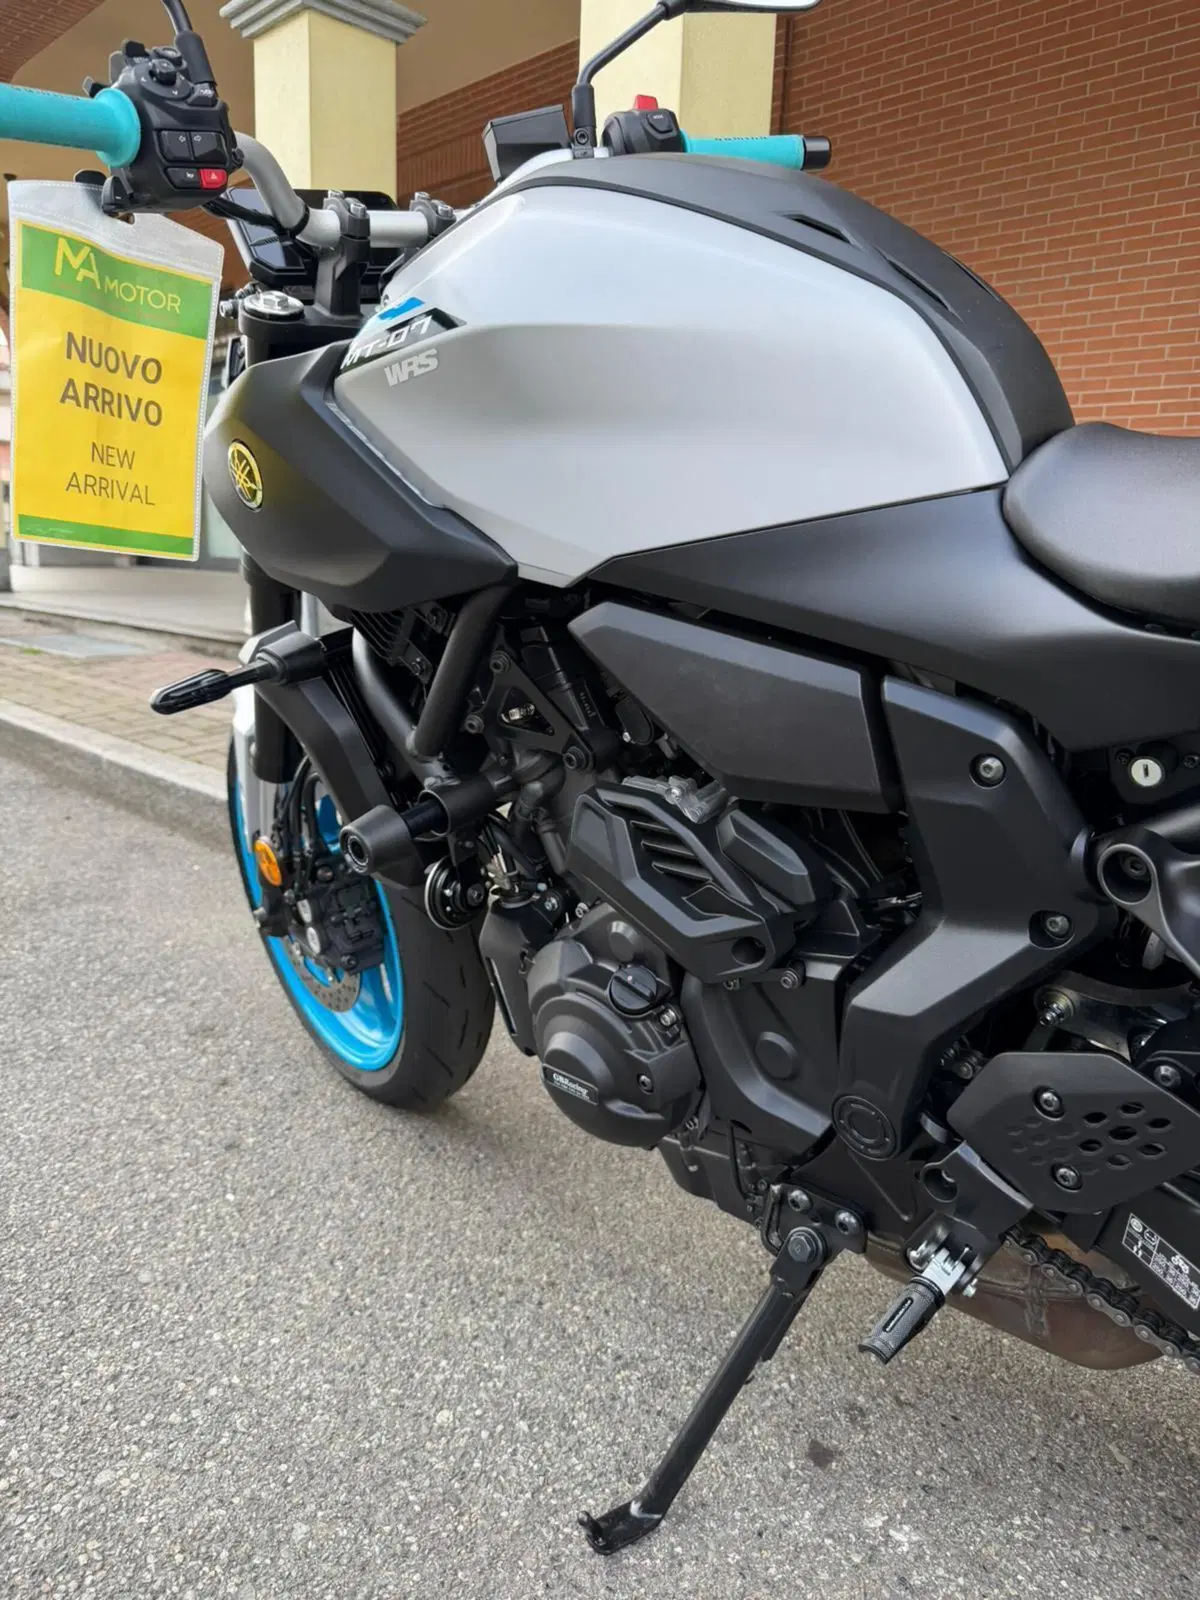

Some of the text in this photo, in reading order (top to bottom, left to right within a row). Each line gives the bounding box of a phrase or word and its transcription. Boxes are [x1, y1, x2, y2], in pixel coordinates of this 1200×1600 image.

[54, 237, 181, 314] MA MOTOR
[66, 331, 163, 385] NUOVO
[383, 347, 438, 388] WRS
[60, 377, 163, 427] ARRIVO
[91, 441, 135, 470] NEW
[65, 471, 155, 506] ARRIVAL
